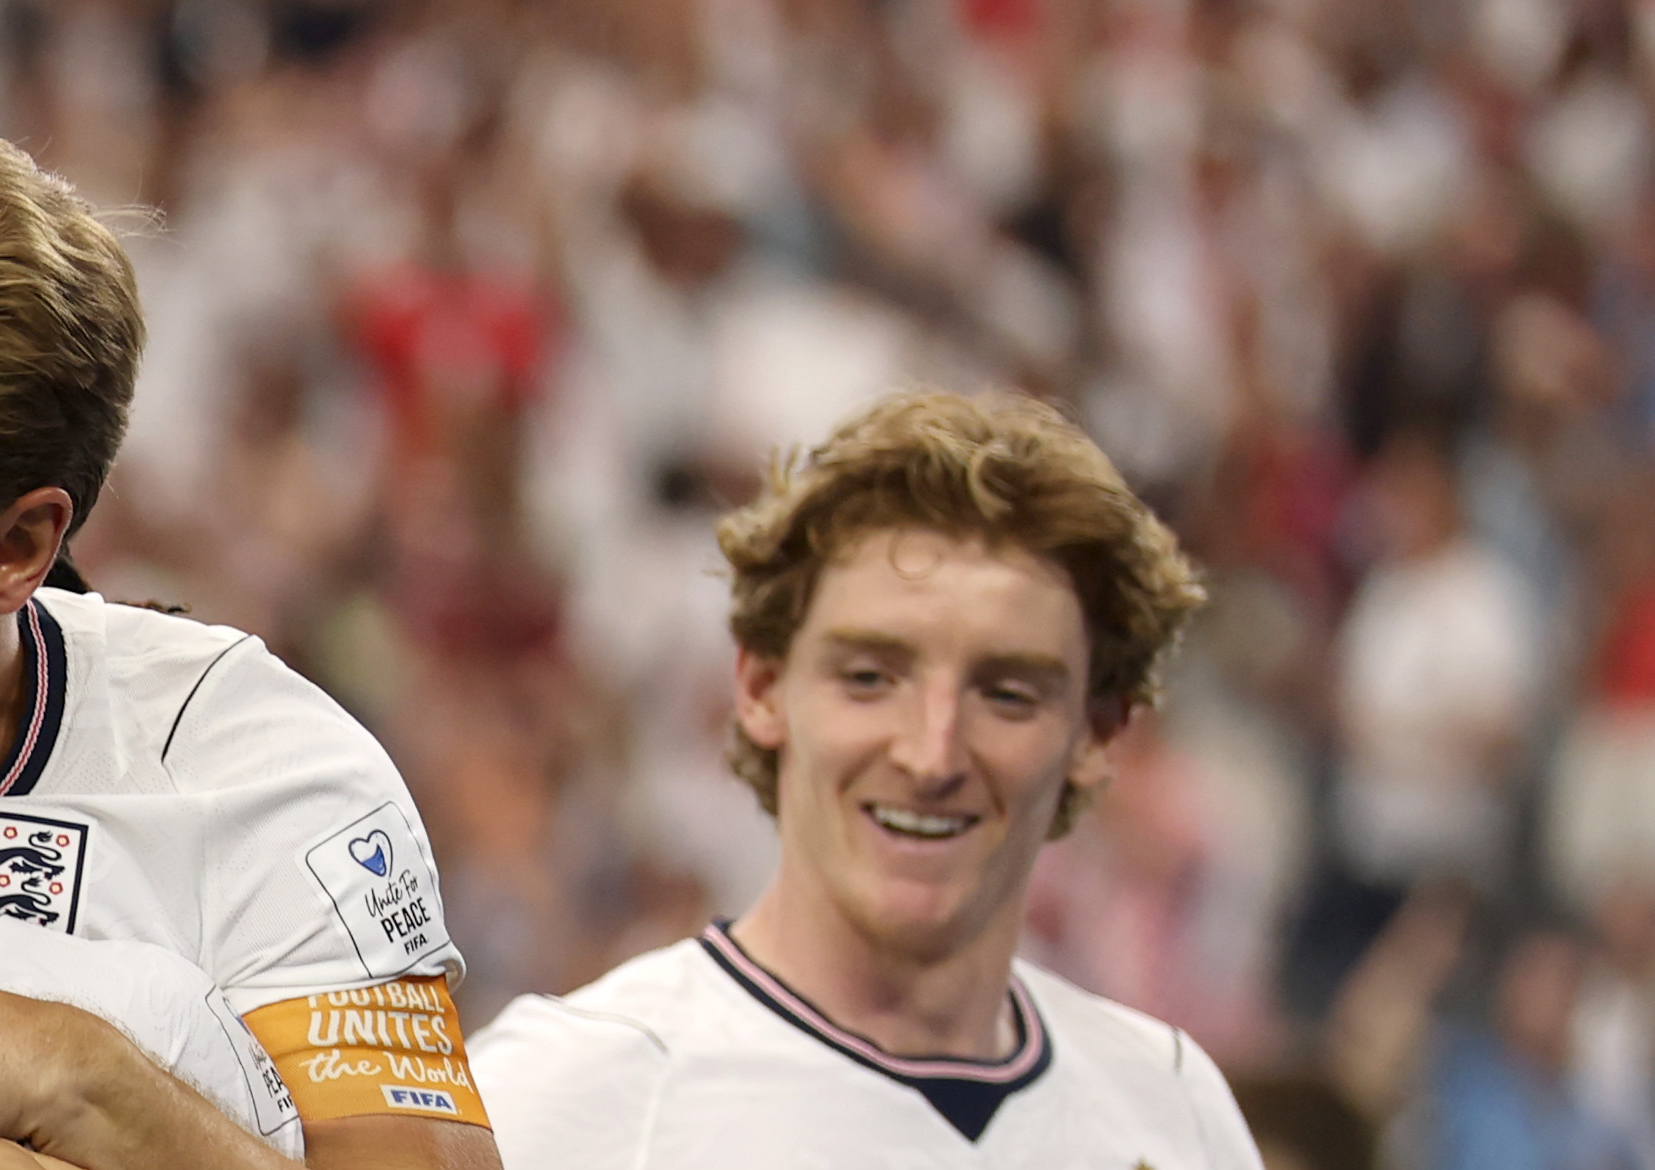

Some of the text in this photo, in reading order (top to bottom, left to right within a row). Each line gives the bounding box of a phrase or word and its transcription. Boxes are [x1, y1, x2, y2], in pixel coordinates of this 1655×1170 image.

[364, 869, 419, 918] Unite For
[380, 896, 432, 943] PEACE
[404, 933, 428, 956] FIFA
[307, 1009, 453, 1055] UNITES
[299, 1048, 382, 1083] the
[383, 1051, 474, 1094] World
[390, 1089, 453, 1111] FIFA
